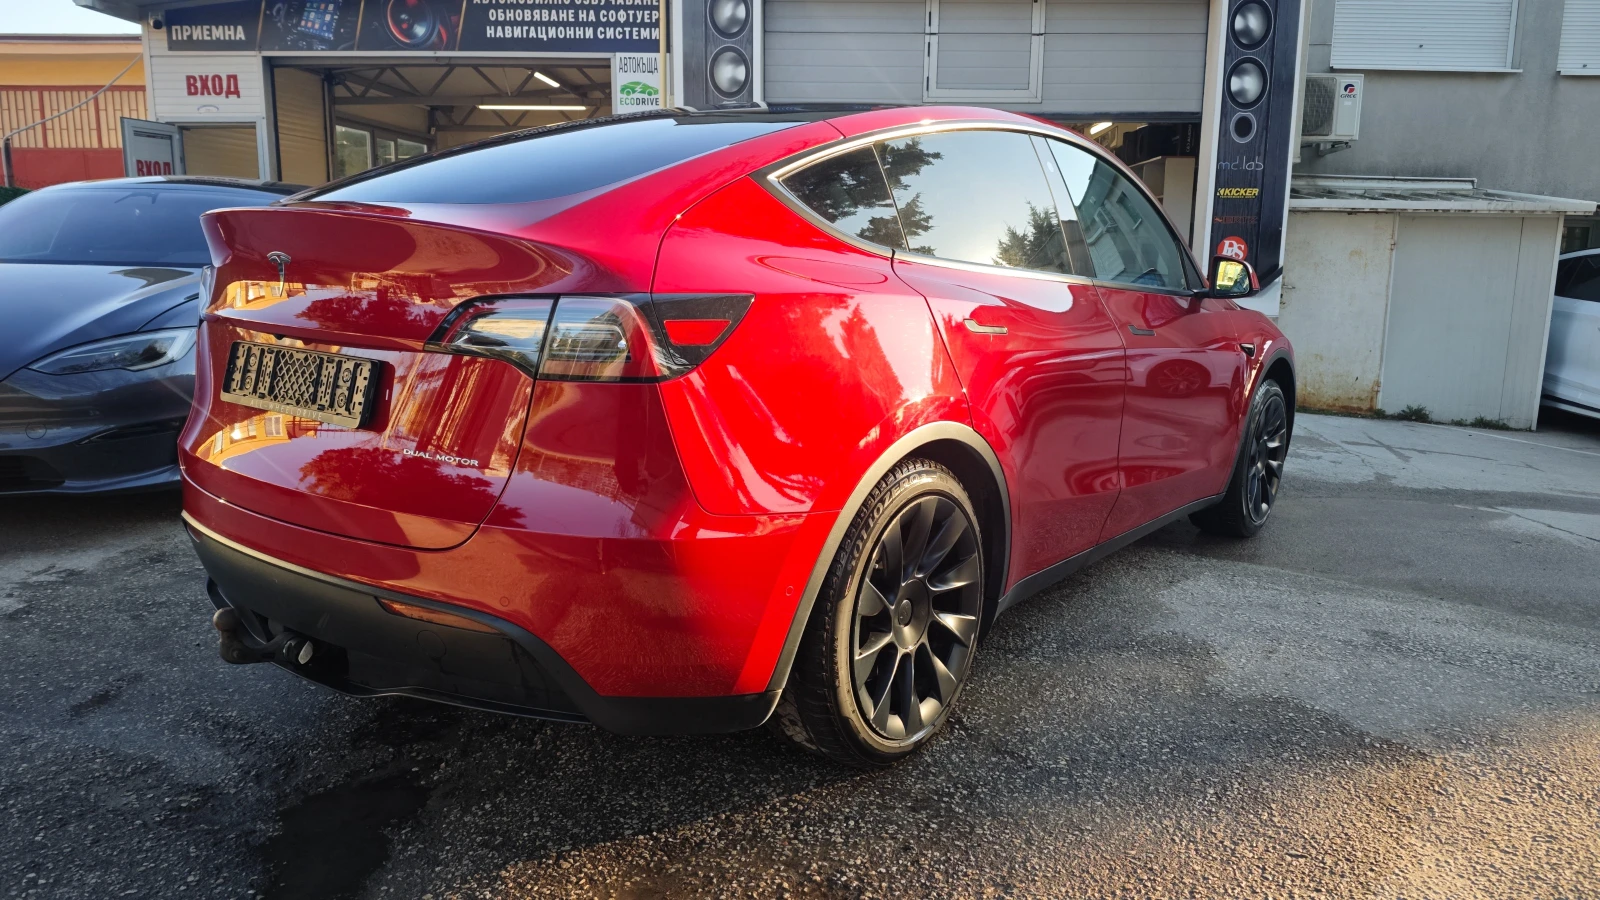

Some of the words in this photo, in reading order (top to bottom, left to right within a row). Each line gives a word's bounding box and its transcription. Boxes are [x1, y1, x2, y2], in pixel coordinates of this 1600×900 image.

[488, 9, 575, 22] ОБНОВЯВАНЕ
[578, 10, 596, 22] НА
[599, 9, 659, 23] СОФТУЕР
[171, 25, 246, 41] ПРИЕМНА
[486, 26, 594, 41] НАВИГАЦИОННИ
[597, 27, 660, 40] СИСТЕМИ
[619, 56, 659, 75] АВТОКЪЩА
[185, 74, 241, 99] ВХОД
[619, 97, 660, 106] ECODRIVE
[1224, 187, 1260, 197] KICKER
[296, 408, 323, 421] DRIVE
[403, 448, 433, 460] DUAL
[435, 454, 479, 467] MOTOR
